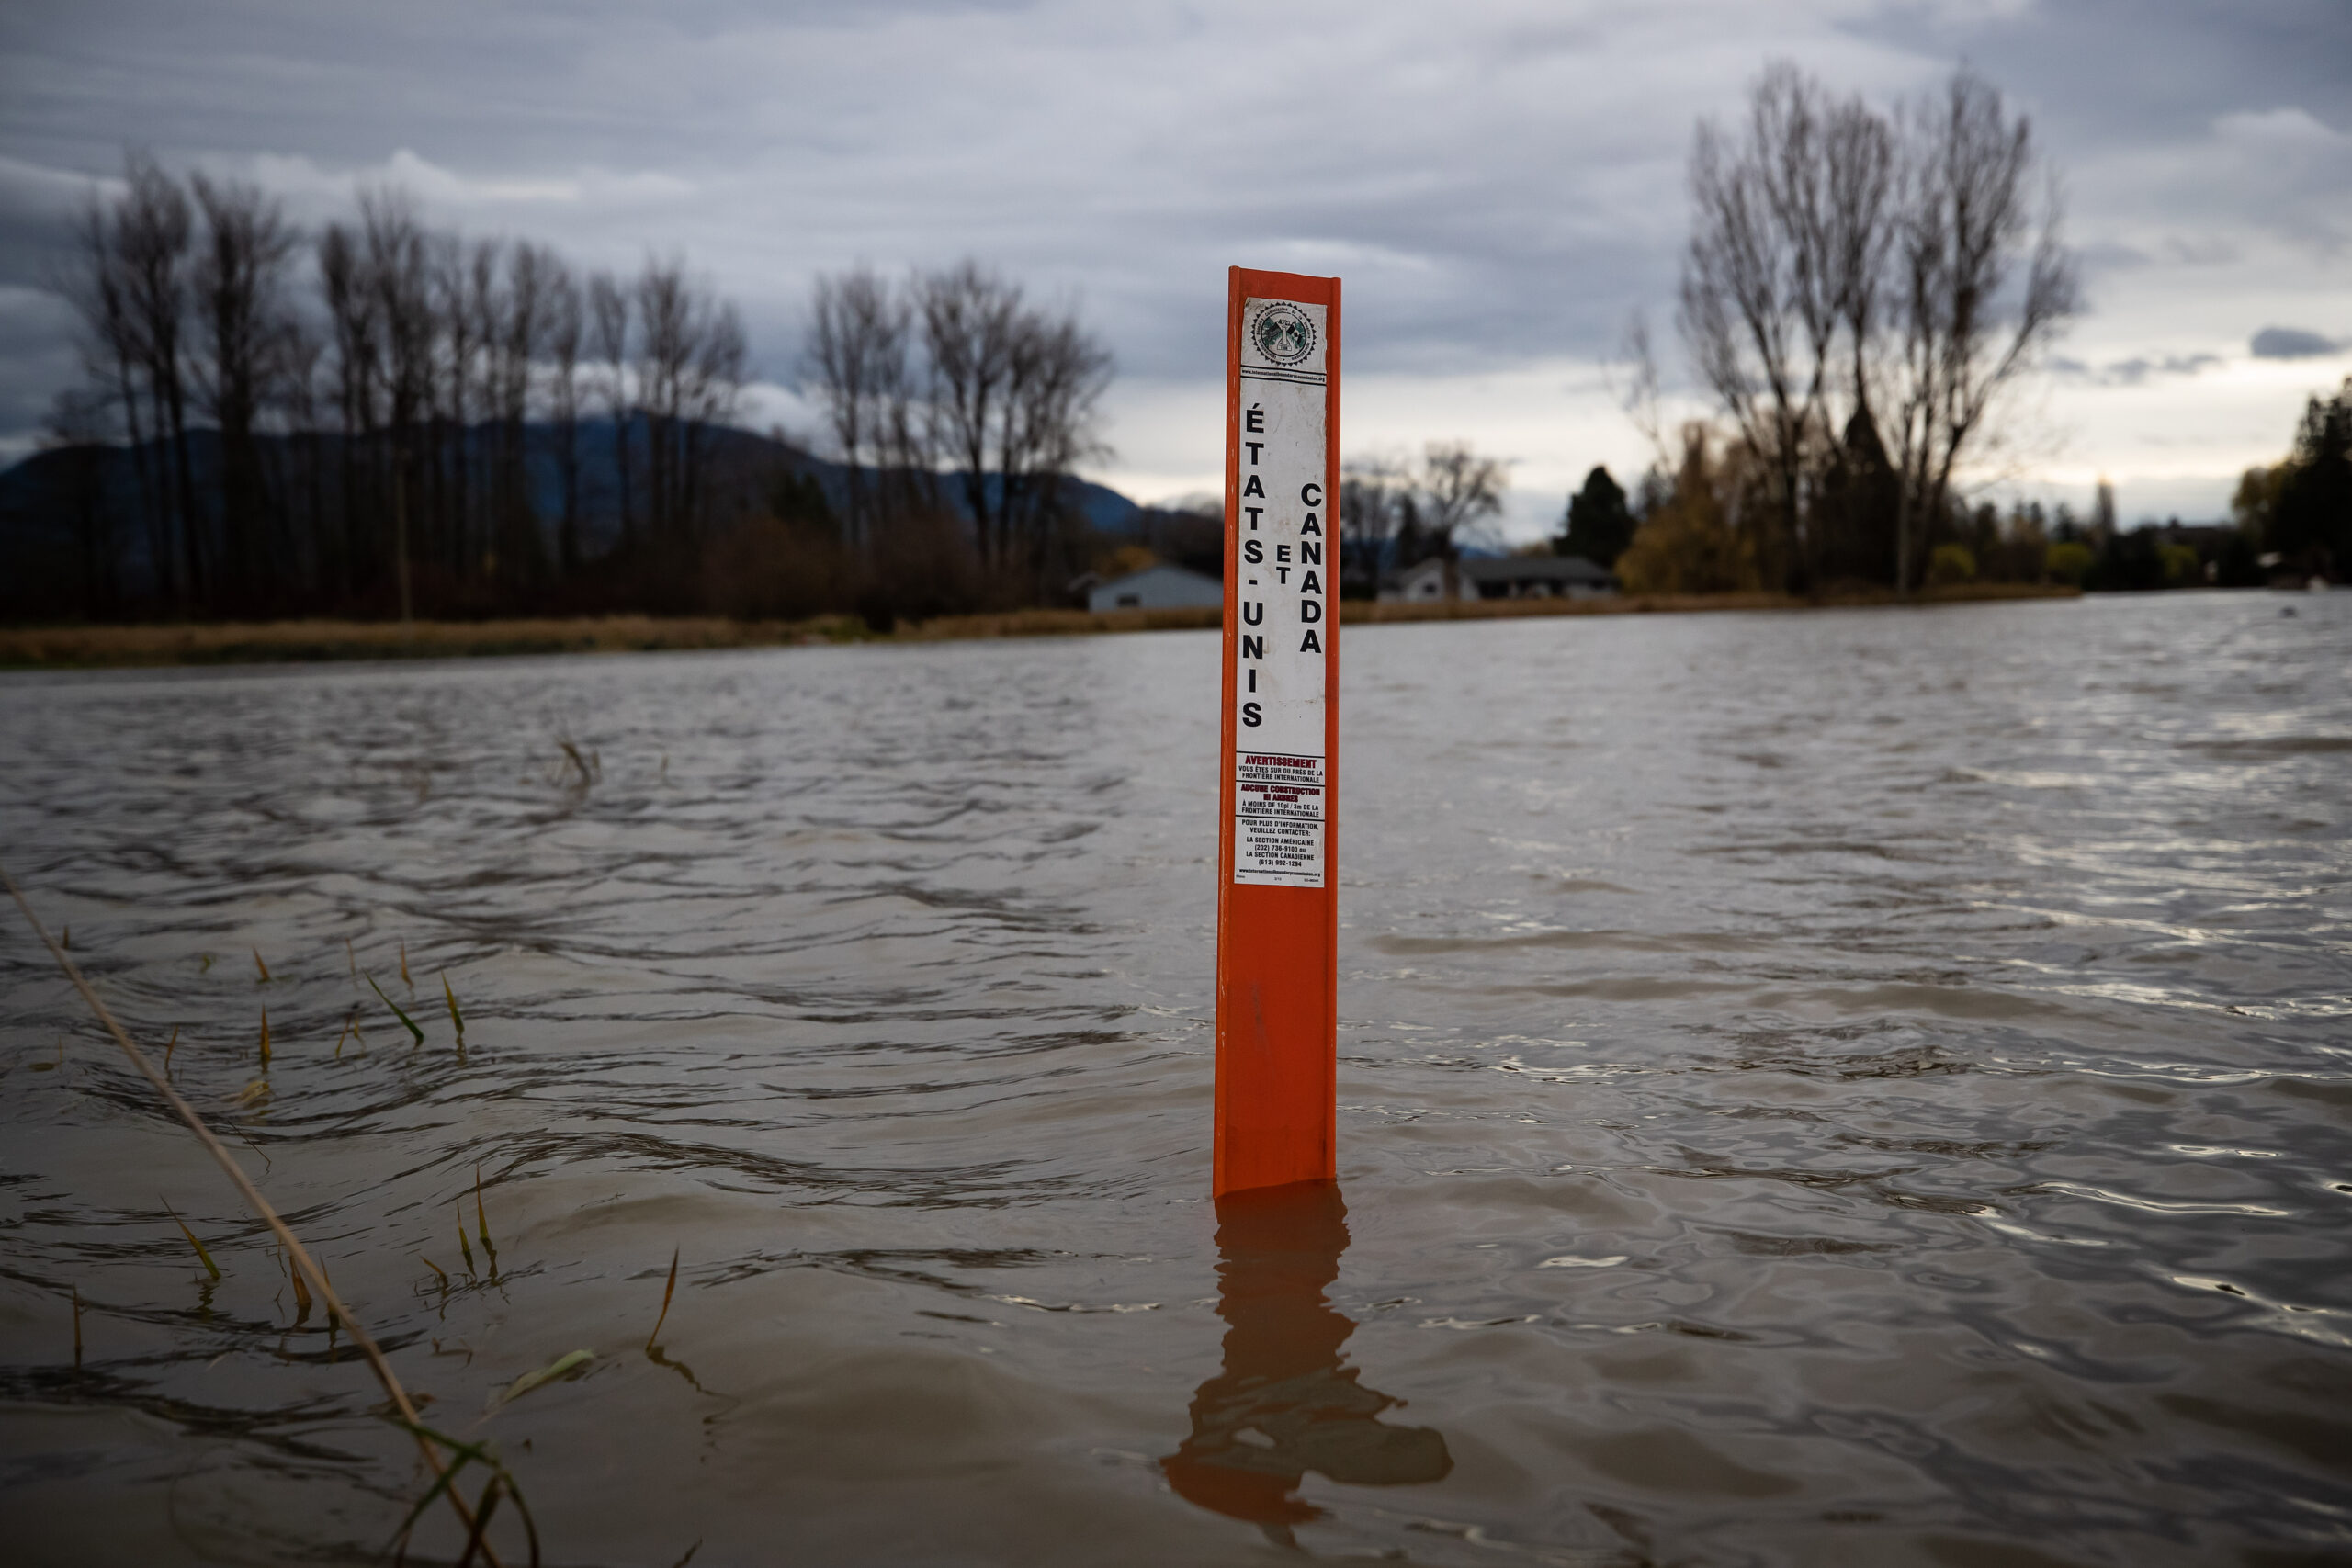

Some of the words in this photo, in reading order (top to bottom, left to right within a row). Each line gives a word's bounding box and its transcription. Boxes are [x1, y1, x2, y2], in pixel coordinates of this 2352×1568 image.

[1242, 403, 1265, 728] ÉTATS-UNIS
[1276, 545, 1291, 584] ET
[1300, 483, 1322, 654] CANADA
[1245, 755, 1317, 768] AVERTISSEMENT
[1275, 774, 1319, 783] INTERNATIONALE
[1271, 785, 1320, 795] CONSTRUCTION
[1272, 794, 1298, 802] ARBRES
[1275, 821, 1318, 830] D'INFORMATION,
